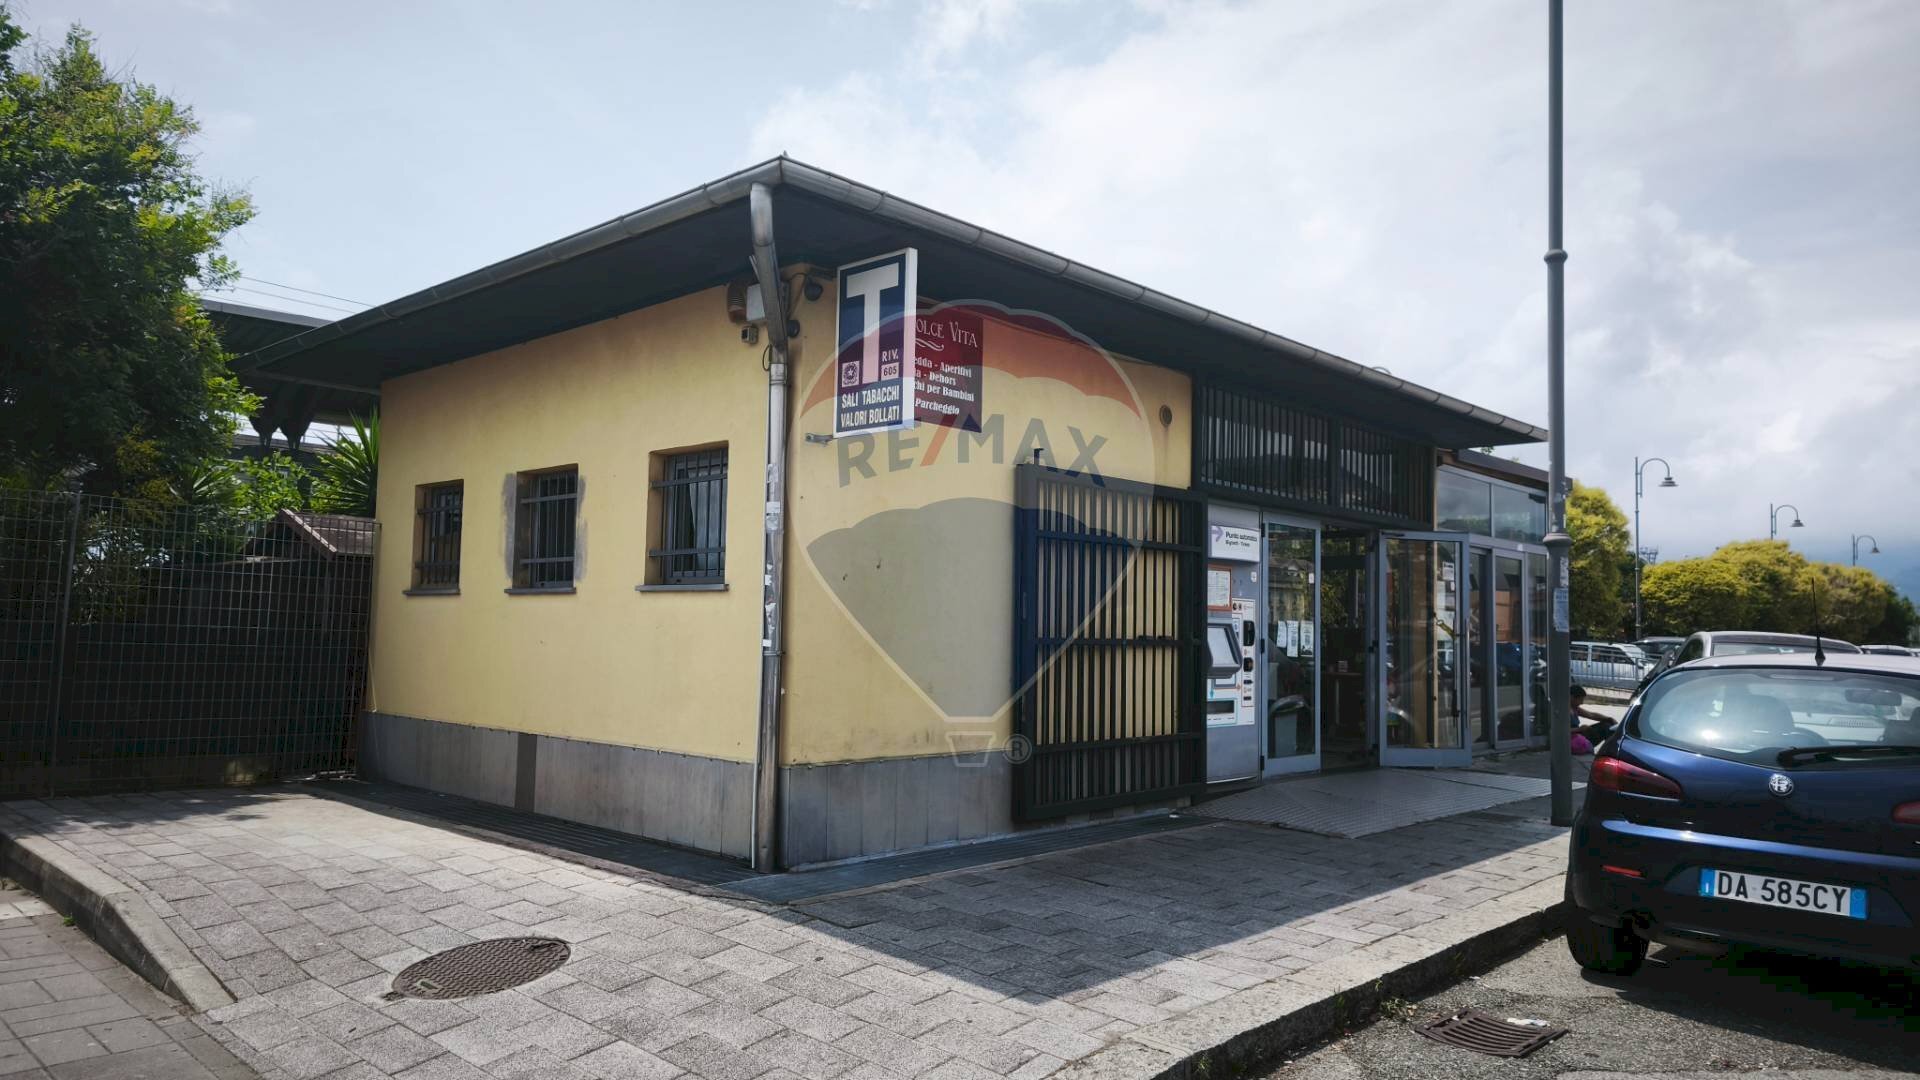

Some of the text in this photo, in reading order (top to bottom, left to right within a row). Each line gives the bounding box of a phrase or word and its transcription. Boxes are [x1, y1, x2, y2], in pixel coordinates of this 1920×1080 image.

[846, 262, 900, 384] T
[916, 318, 978, 349] OLCE VITA
[882, 348, 899, 362] RIV.
[883, 365, 897, 377] 605
[842, 385, 900, 408] SALI TABACCHI
[927, 384, 941, 395] per
[942, 386, 975, 402] Bambini
[915, 397, 960, 415] Parcheggio
[841, 405, 900, 428] VALORI BOLLATI
